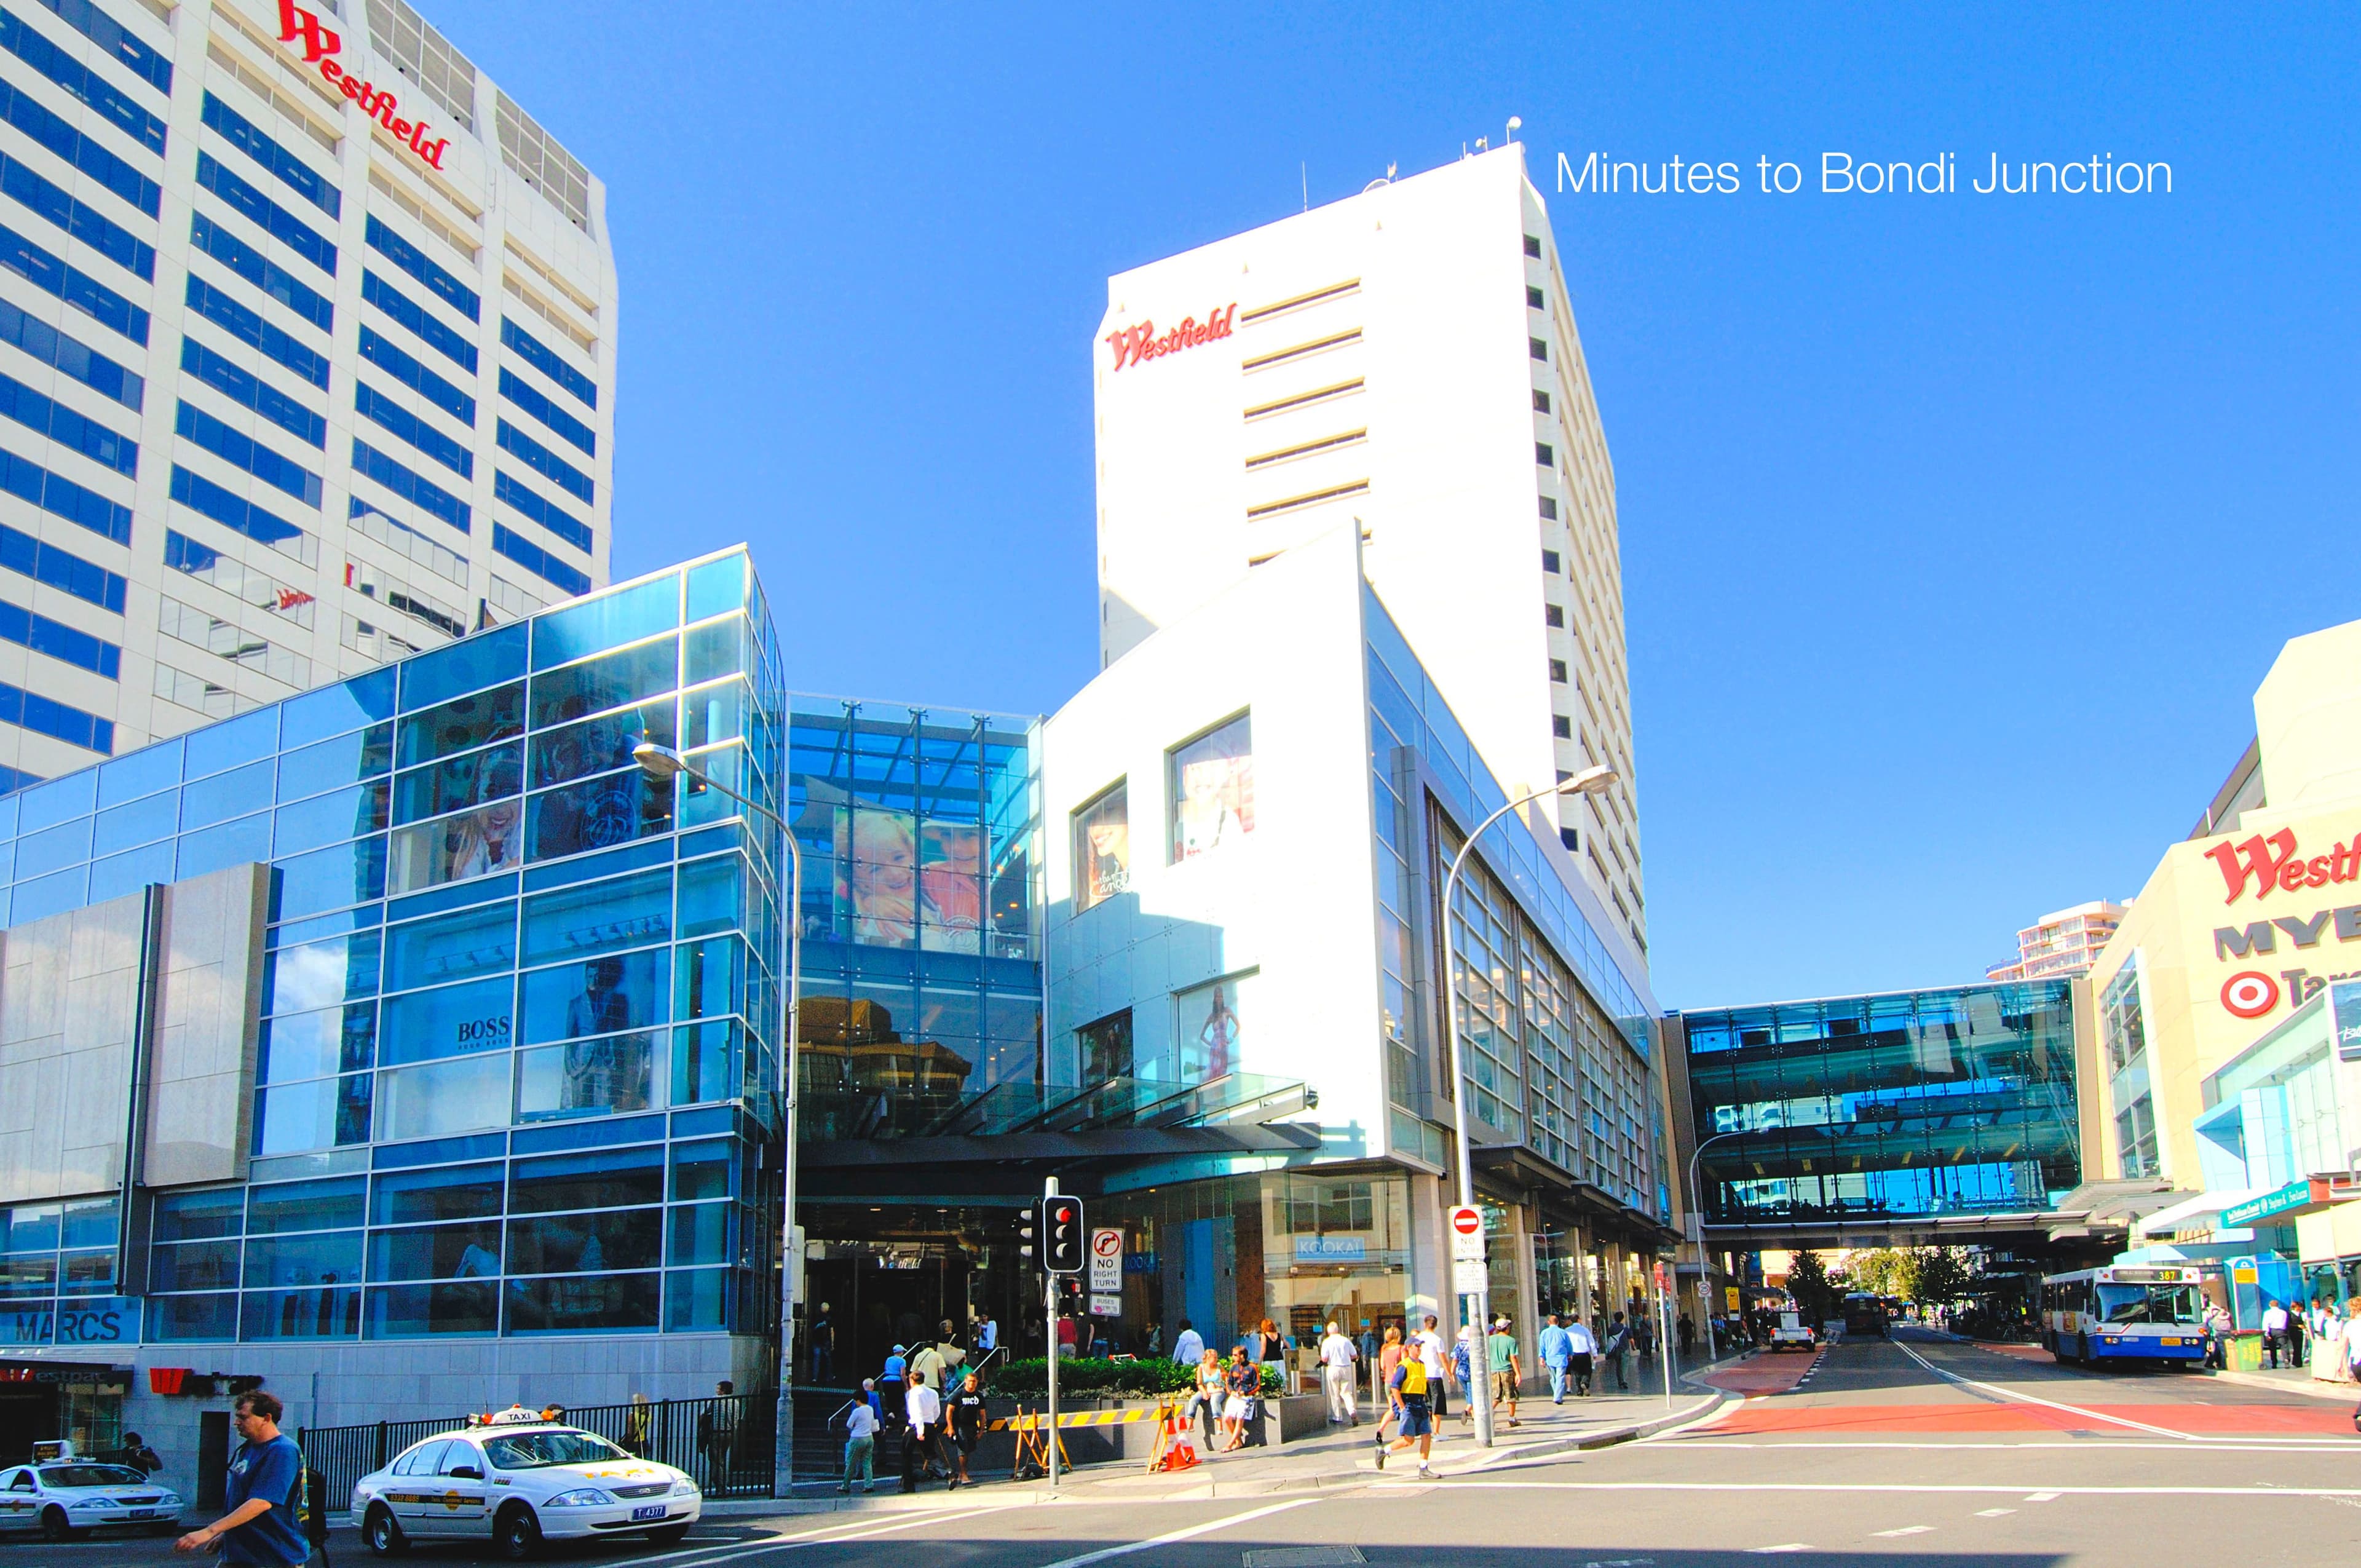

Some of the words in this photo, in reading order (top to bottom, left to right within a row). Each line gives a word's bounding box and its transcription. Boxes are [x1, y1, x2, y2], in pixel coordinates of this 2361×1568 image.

[277, 0, 451, 171] Westfield
[1105, 302, 1238, 373] Westfield
[458, 1016, 510, 1042] BOSS
[1097, 1259, 1113, 1269] NO
[2159, 1270, 2175, 1280] 387
[16, 1312, 121, 1342] MARCS
[507, 1412, 531, 1421] TAXI
